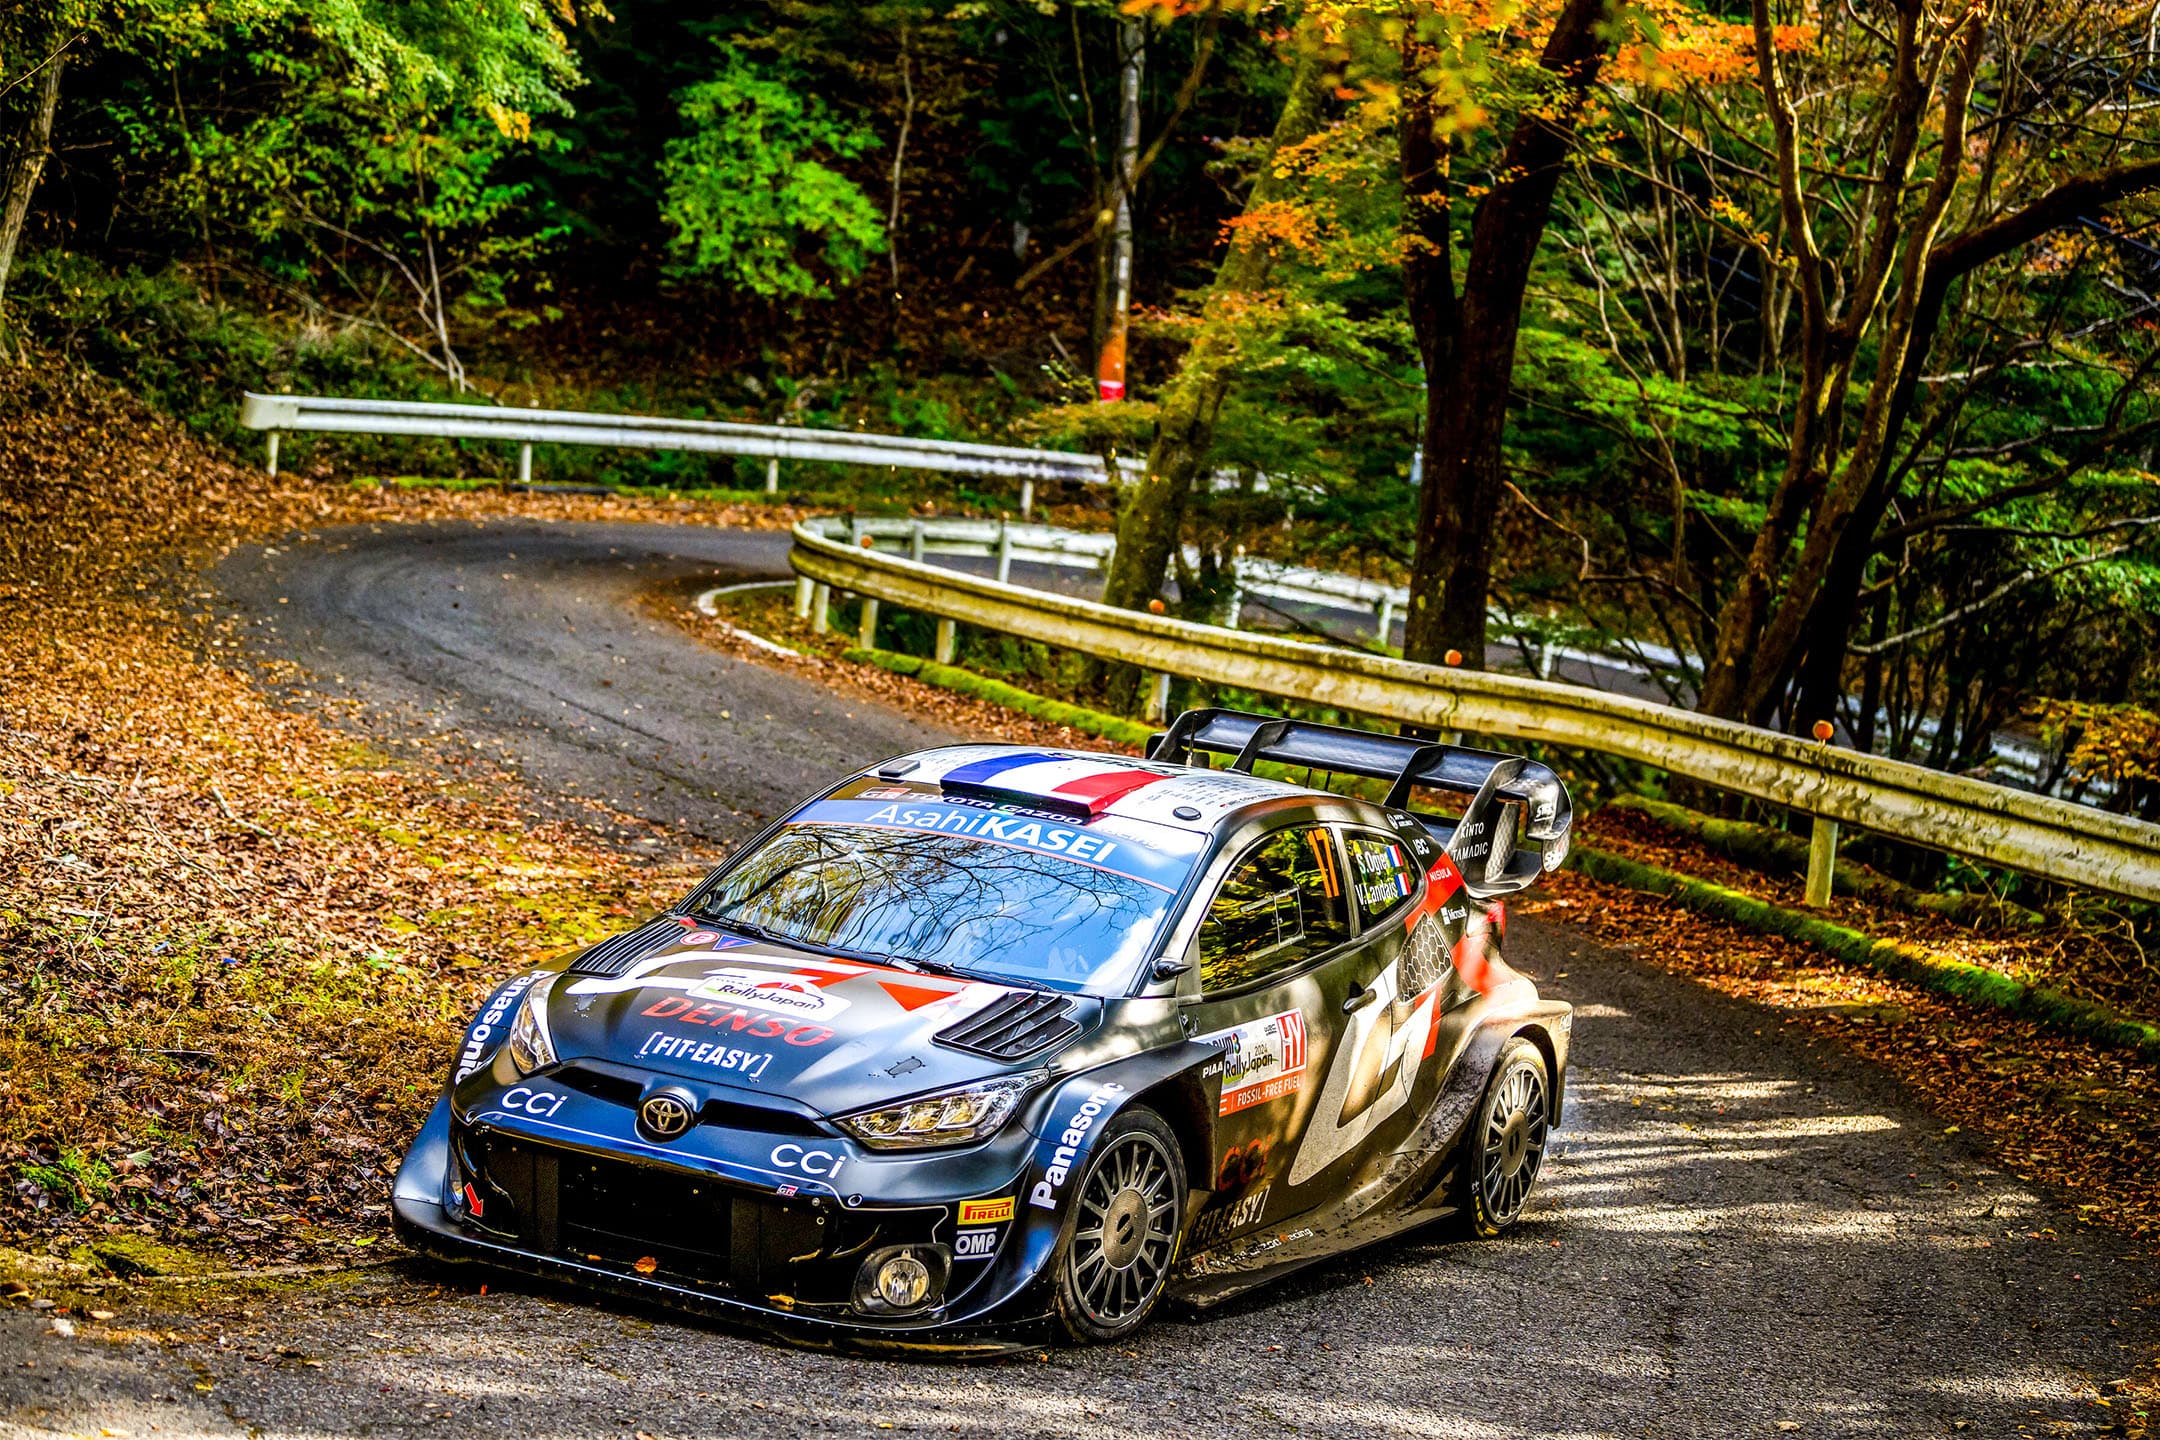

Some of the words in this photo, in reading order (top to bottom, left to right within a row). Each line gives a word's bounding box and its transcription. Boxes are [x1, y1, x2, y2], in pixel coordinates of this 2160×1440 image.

[998, 804, 1083, 825] GAZOO
[864, 804, 1118, 864] AsahiKASEI
[1460, 822, 1484, 839] KINTO
[1307, 828, 1340, 898] 17
[1452, 842, 1489, 861] TAMADIC
[1429, 867, 1452, 882] NISULA
[1355, 878, 1398, 906] V.Landais
[641, 996, 835, 1046] DENSO
[1203, 1061, 1223, 1078] PIAA
[1225, 1052, 1273, 1079] RallyJapan
[1237, 1081, 1283, 1106] FOSSIL-FREE
[1284, 1075, 1301, 1090] FUEL
[1029, 1082, 1125, 1210] Panasonic
[963, 1201, 1011, 1221] PIRELLI
[955, 1232, 997, 1255] OMP
